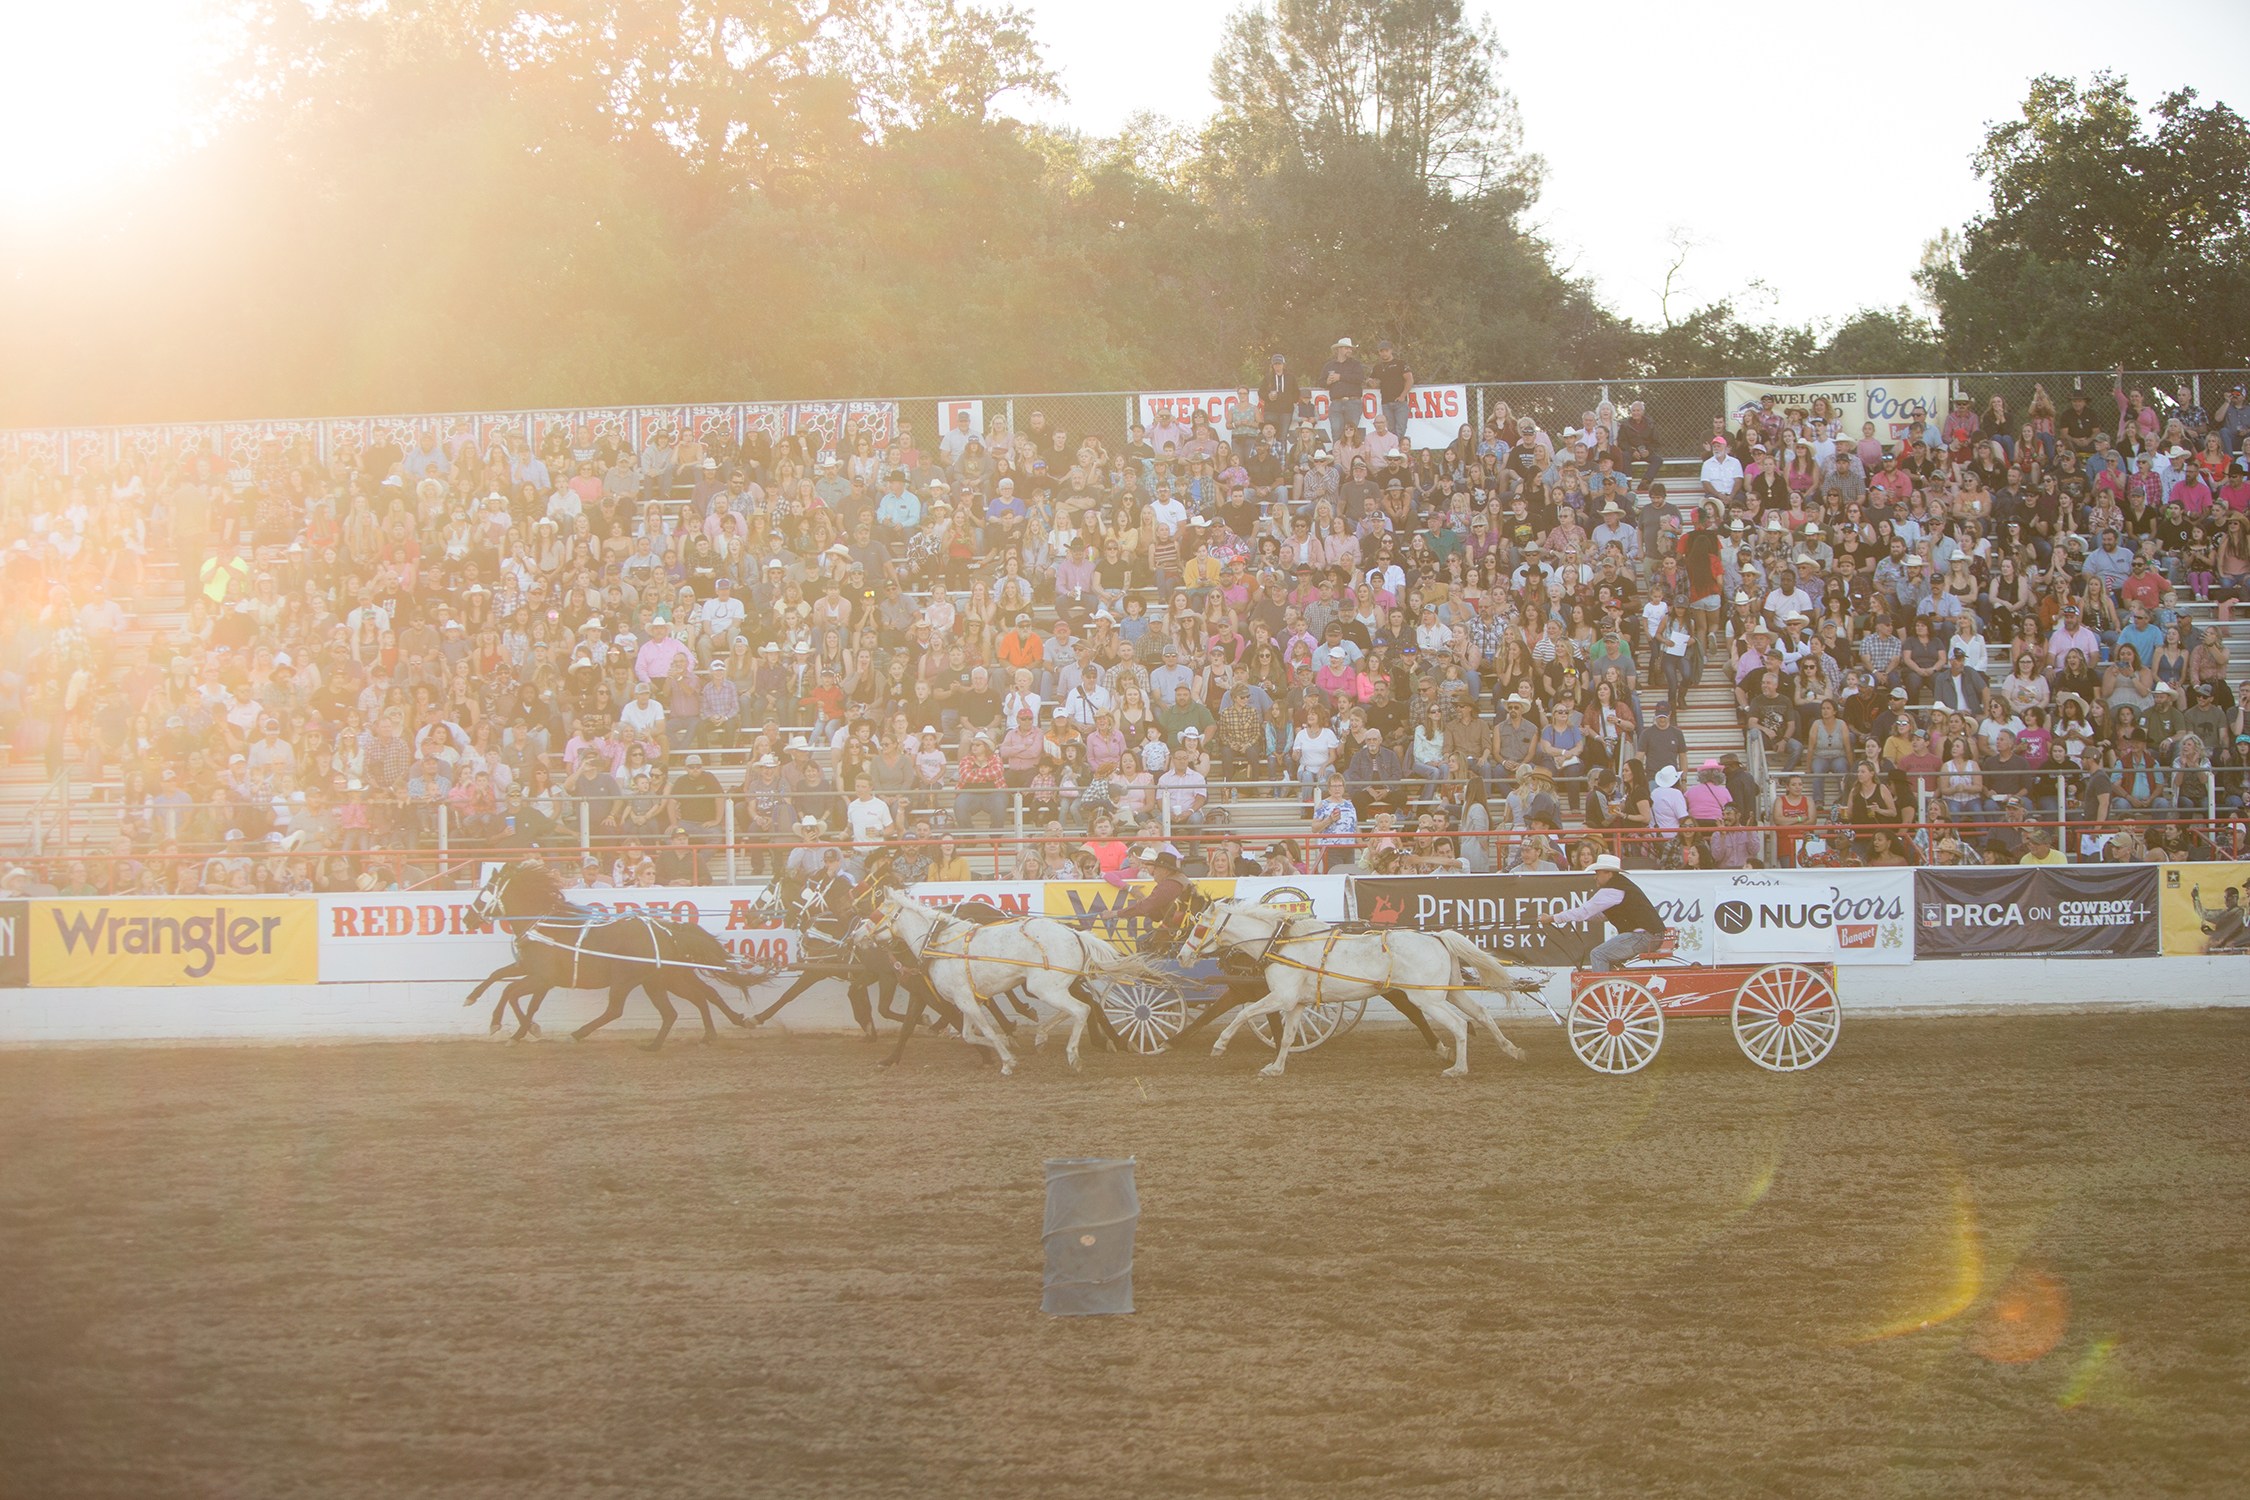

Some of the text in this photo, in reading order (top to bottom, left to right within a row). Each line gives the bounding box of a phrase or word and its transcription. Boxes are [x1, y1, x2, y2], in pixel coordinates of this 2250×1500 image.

[1148, 396, 1265, 425] WELCO
[1407, 390, 1459, 419] ANS
[1866, 387, 1938, 420] Coors
[1414, 890, 1590, 934] PENDLETON
[1655, 897, 1704, 923] ors
[1760, 903, 1832, 929] NUG
[1945, 902, 2051, 927] PRCA ON
[2058, 899, 2134, 915] COWBOY
[2058, 914, 2134, 927] CHANNEL
[51, 907, 281, 978] Wrangler
[1468, 934, 1548, 949] HISKY
[1841, 926, 1876, 947] Banquet
[724, 938, 789, 969] 1948
